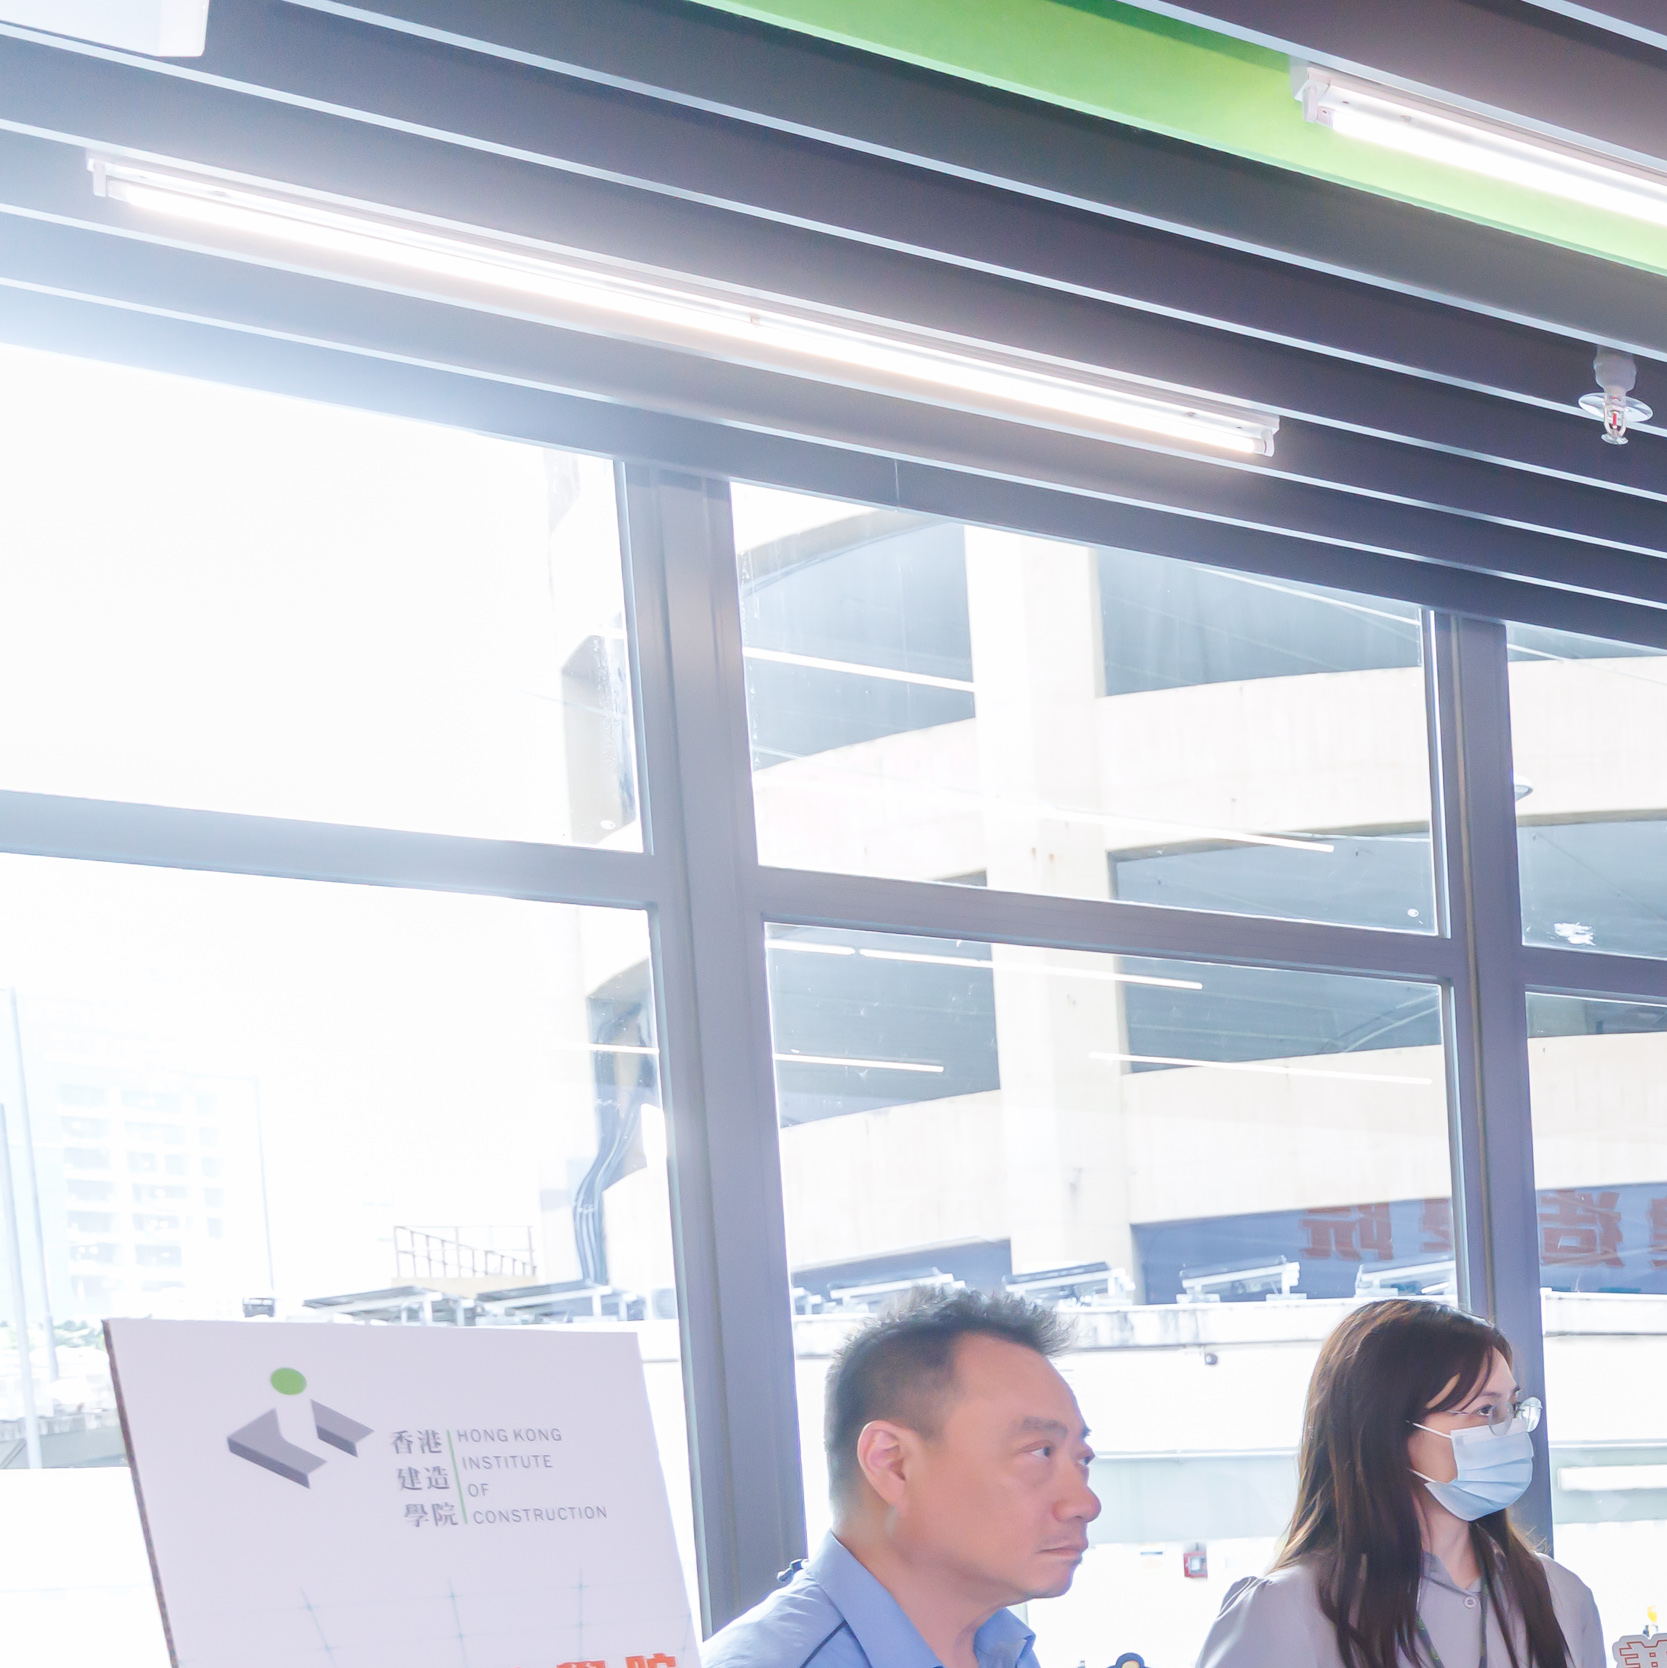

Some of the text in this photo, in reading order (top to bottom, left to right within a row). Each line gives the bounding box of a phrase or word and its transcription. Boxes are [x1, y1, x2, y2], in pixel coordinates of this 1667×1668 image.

[390, 1429, 442, 1455] 香港
[457, 1428, 563, 1444] HONG KONG
[462, 1454, 553, 1470] INSTITUTE
[397, 1466, 450, 1493] 建造
[467, 1482, 490, 1498] OF
[404, 1502, 459, 1529] 學院
[473, 1504, 607, 1524] CONSTRUCTION
